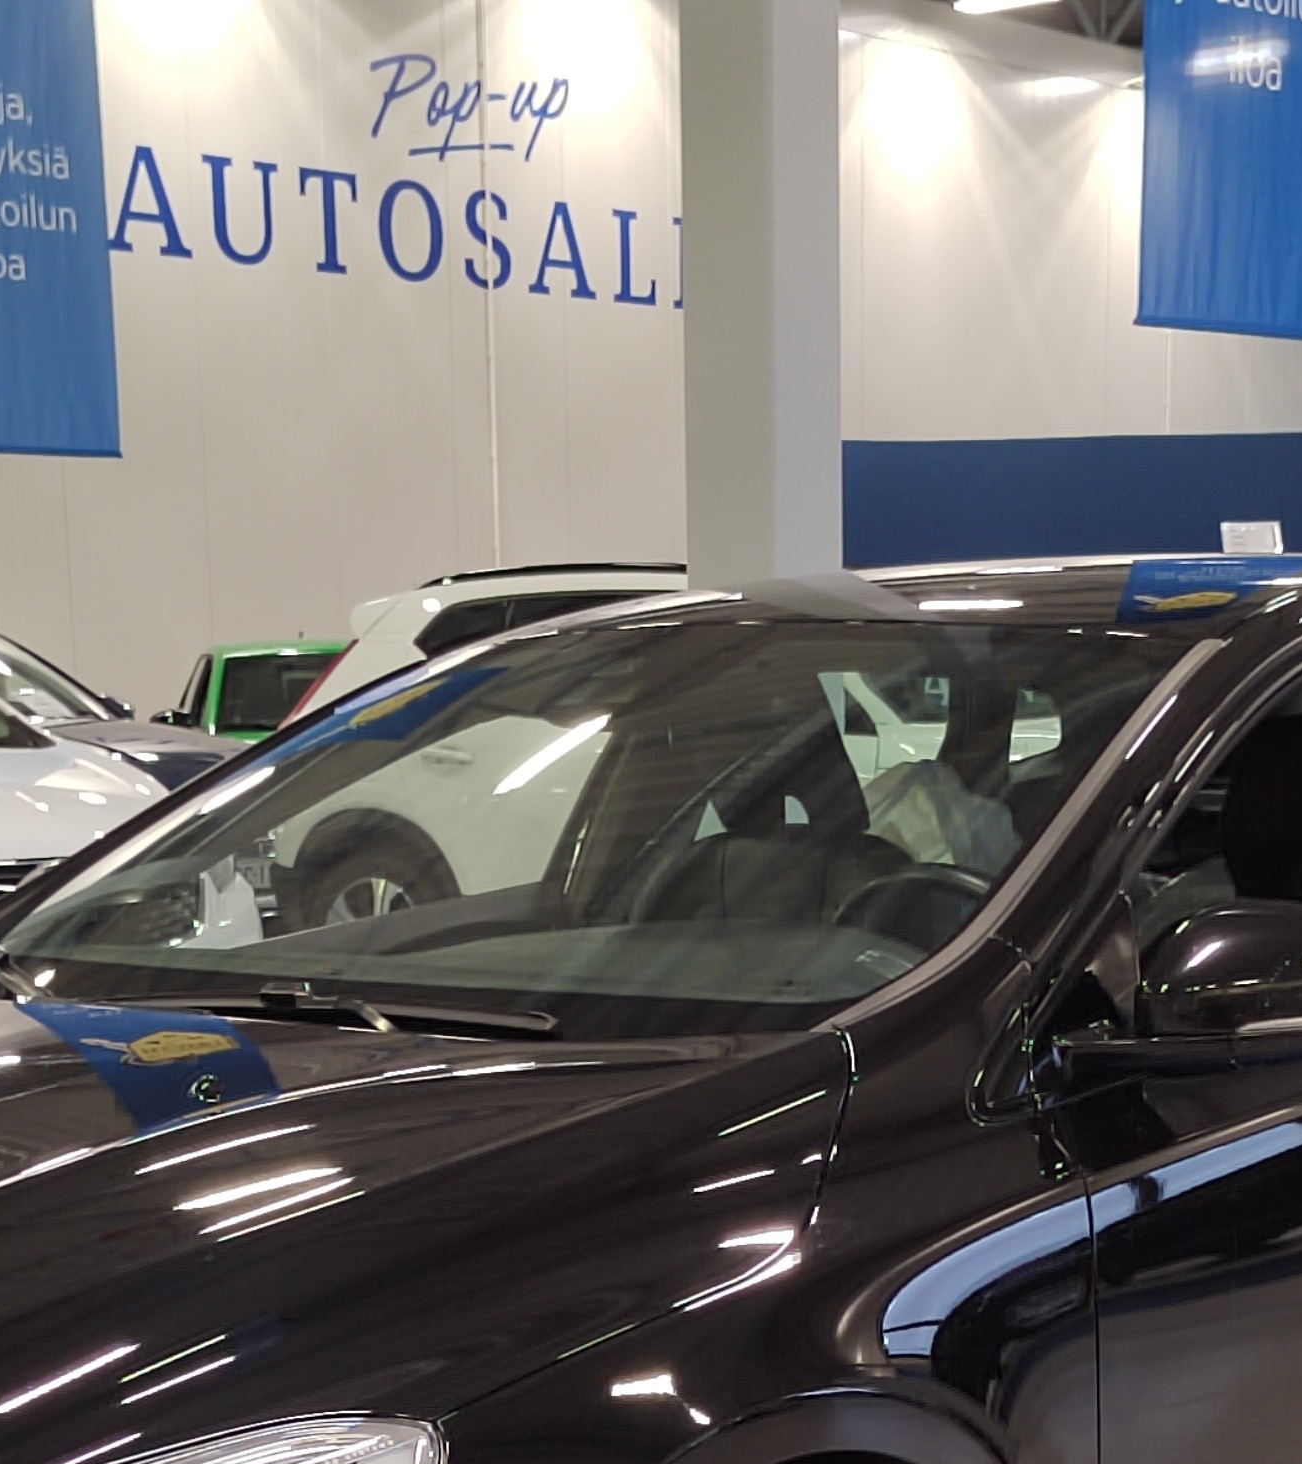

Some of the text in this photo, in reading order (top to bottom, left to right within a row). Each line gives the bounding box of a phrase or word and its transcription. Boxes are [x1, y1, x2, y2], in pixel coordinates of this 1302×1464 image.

[370, 54, 568, 162] Pop-up
[1229, 36, 1283, 91] iloa
[107, 145, 684, 309] AUTOSAL
